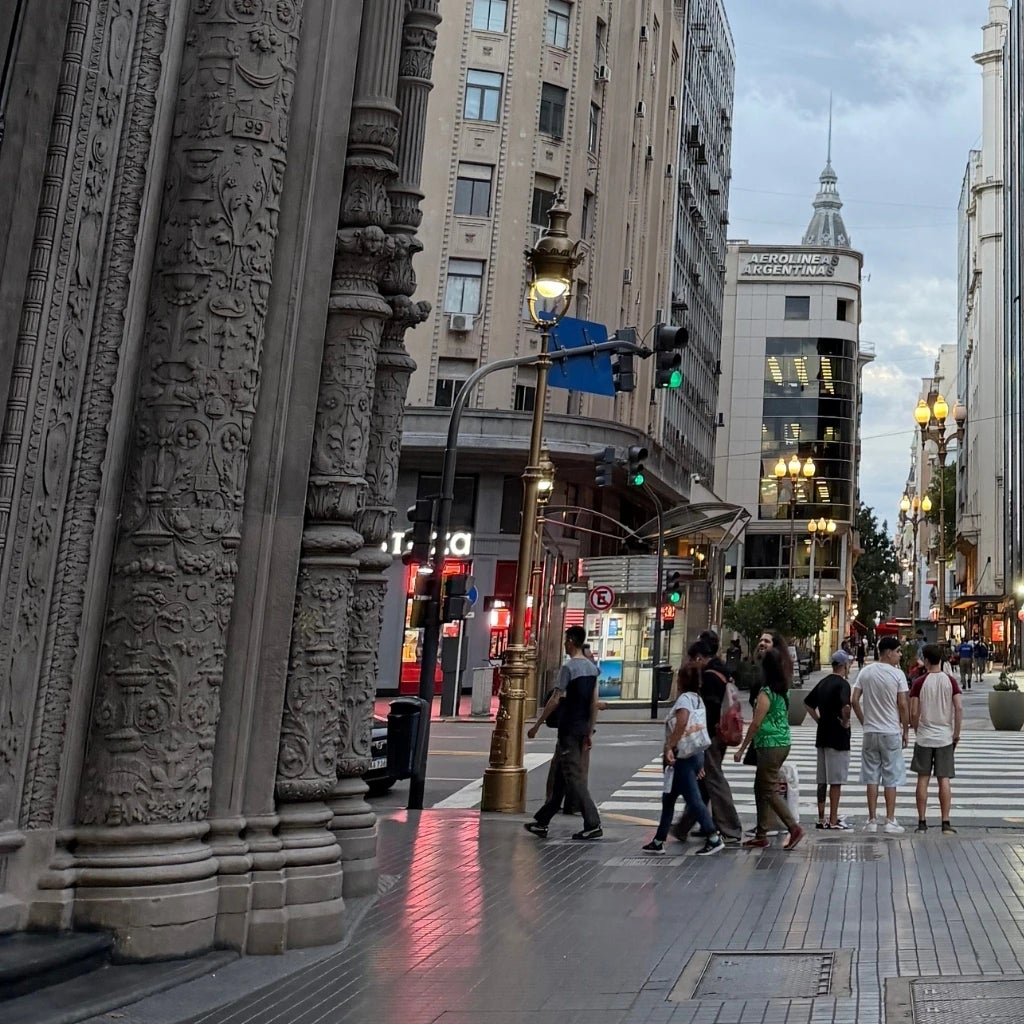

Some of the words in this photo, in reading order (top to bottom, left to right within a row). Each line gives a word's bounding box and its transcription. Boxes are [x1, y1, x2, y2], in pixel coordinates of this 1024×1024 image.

[245, 120, 263, 136] 99
[748, 253, 840, 267] AEROLINEAS
[741, 264, 835, 277] ARGENTINAS
